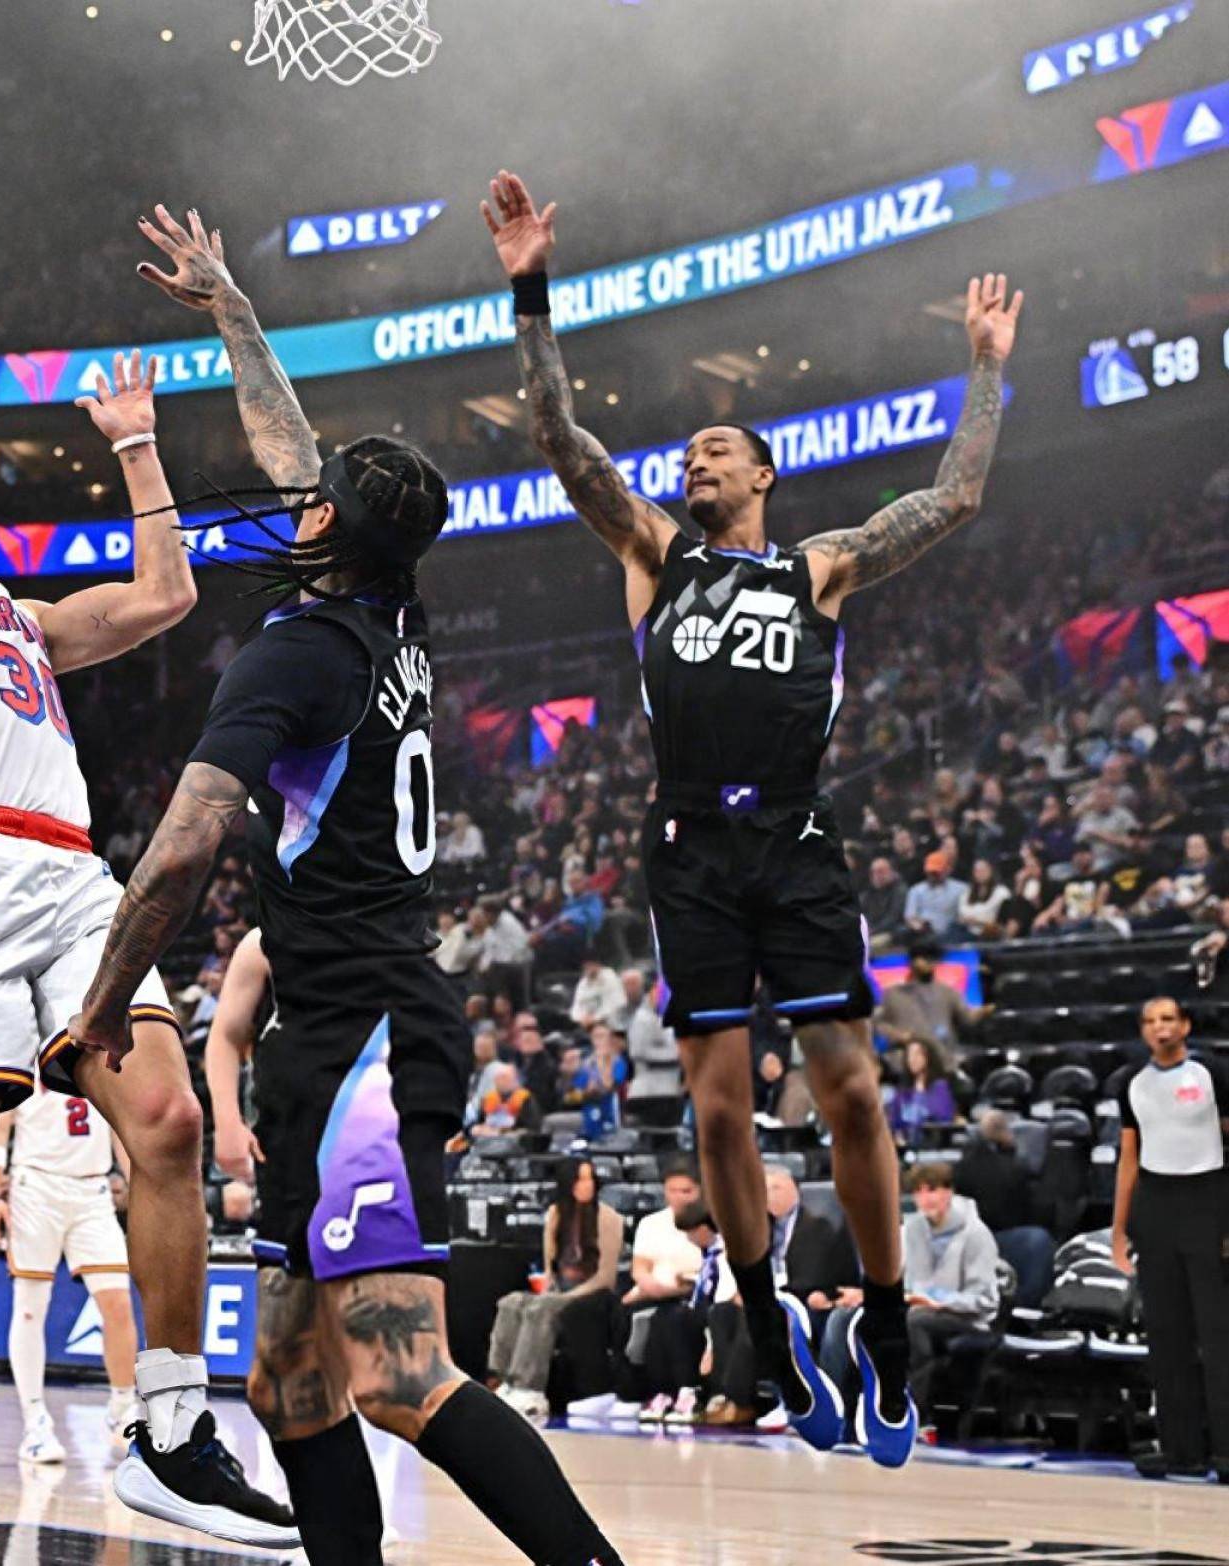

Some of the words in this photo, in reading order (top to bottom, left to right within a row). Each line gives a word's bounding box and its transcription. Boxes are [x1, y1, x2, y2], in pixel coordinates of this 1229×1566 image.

[1066, 8, 1190, 77] DELT
[328, 204, 442, 246] DELT
[374, 297, 517, 361] OFFICIAL
[548, 265, 647, 330] IRLINE
[646, 253, 694, 303] OF
[696, 233, 763, 292] THE
[764, 204, 856, 273] UTAH
[858, 177, 954, 246] JAZZ.
[1153, 336, 1200, 388] 58
[640, 448, 685, 499] OF
[852, 389, 947, 455] JAZZ.
[730, 617, 796, 674] 20
[393, 729, 437, 876] 0
[65, 1097, 90, 1136] 2
